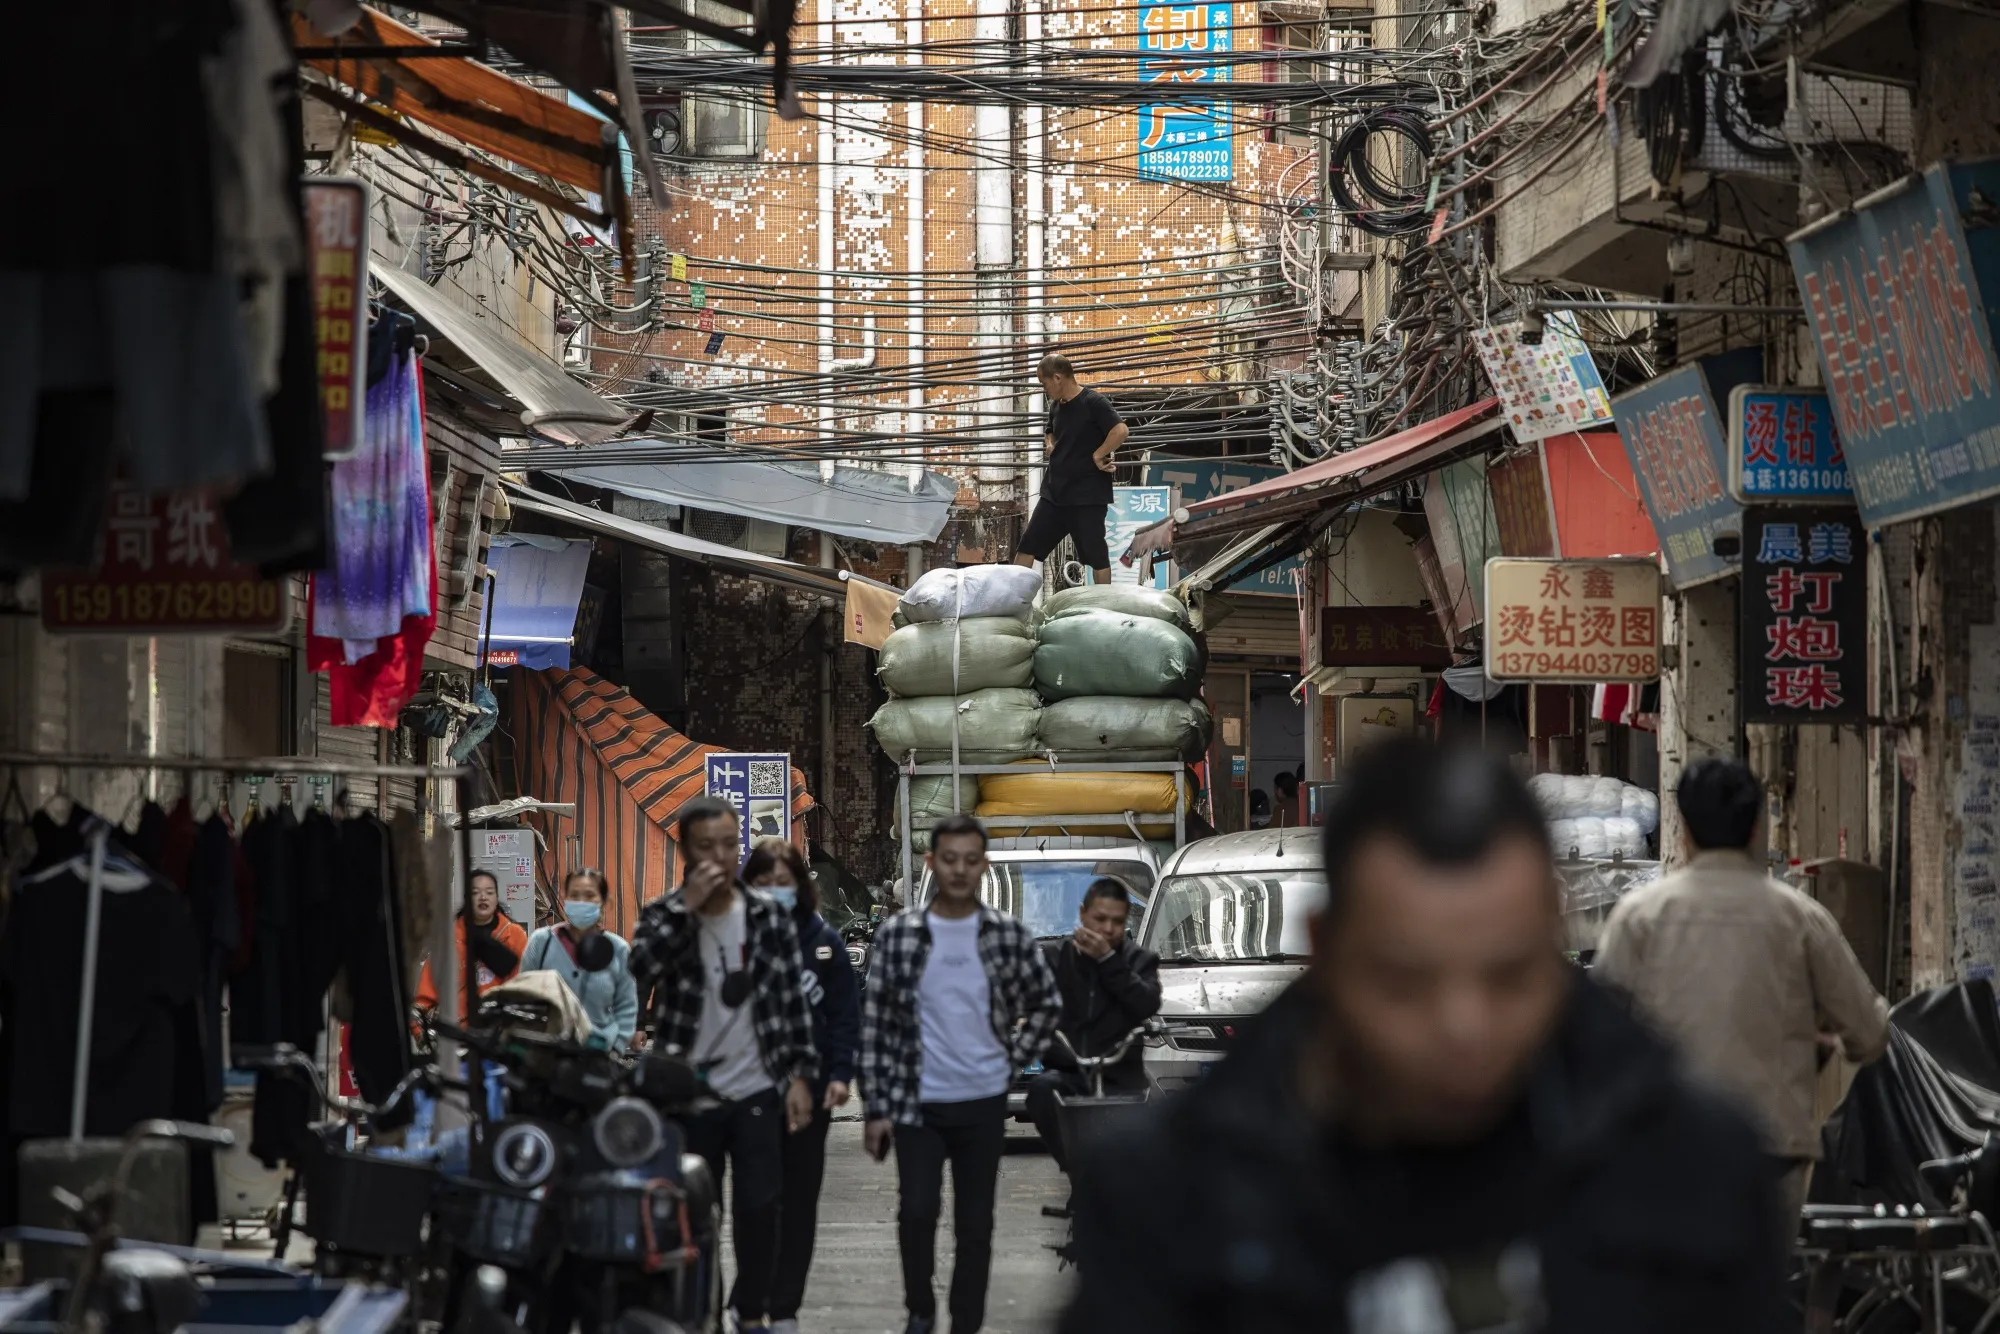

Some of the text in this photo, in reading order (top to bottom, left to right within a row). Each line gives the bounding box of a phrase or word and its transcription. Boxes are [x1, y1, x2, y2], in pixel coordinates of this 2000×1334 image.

[1141, 165, 1229, 178] 17784022238
[1142, 150, 1229, 164] 18584789070
[1744, 401, 1845, 467] 烫钻
[1756, 523, 1853, 564] 晨美
[53, 580, 278, 622] 15918762990
[1540, 567, 1615, 599] 永鑫
[1498, 605, 1656, 648] 烫钻烫图
[1765, 567, 1845, 710] 打炮珠
[1497, 652, 1656, 674] 13794403798
